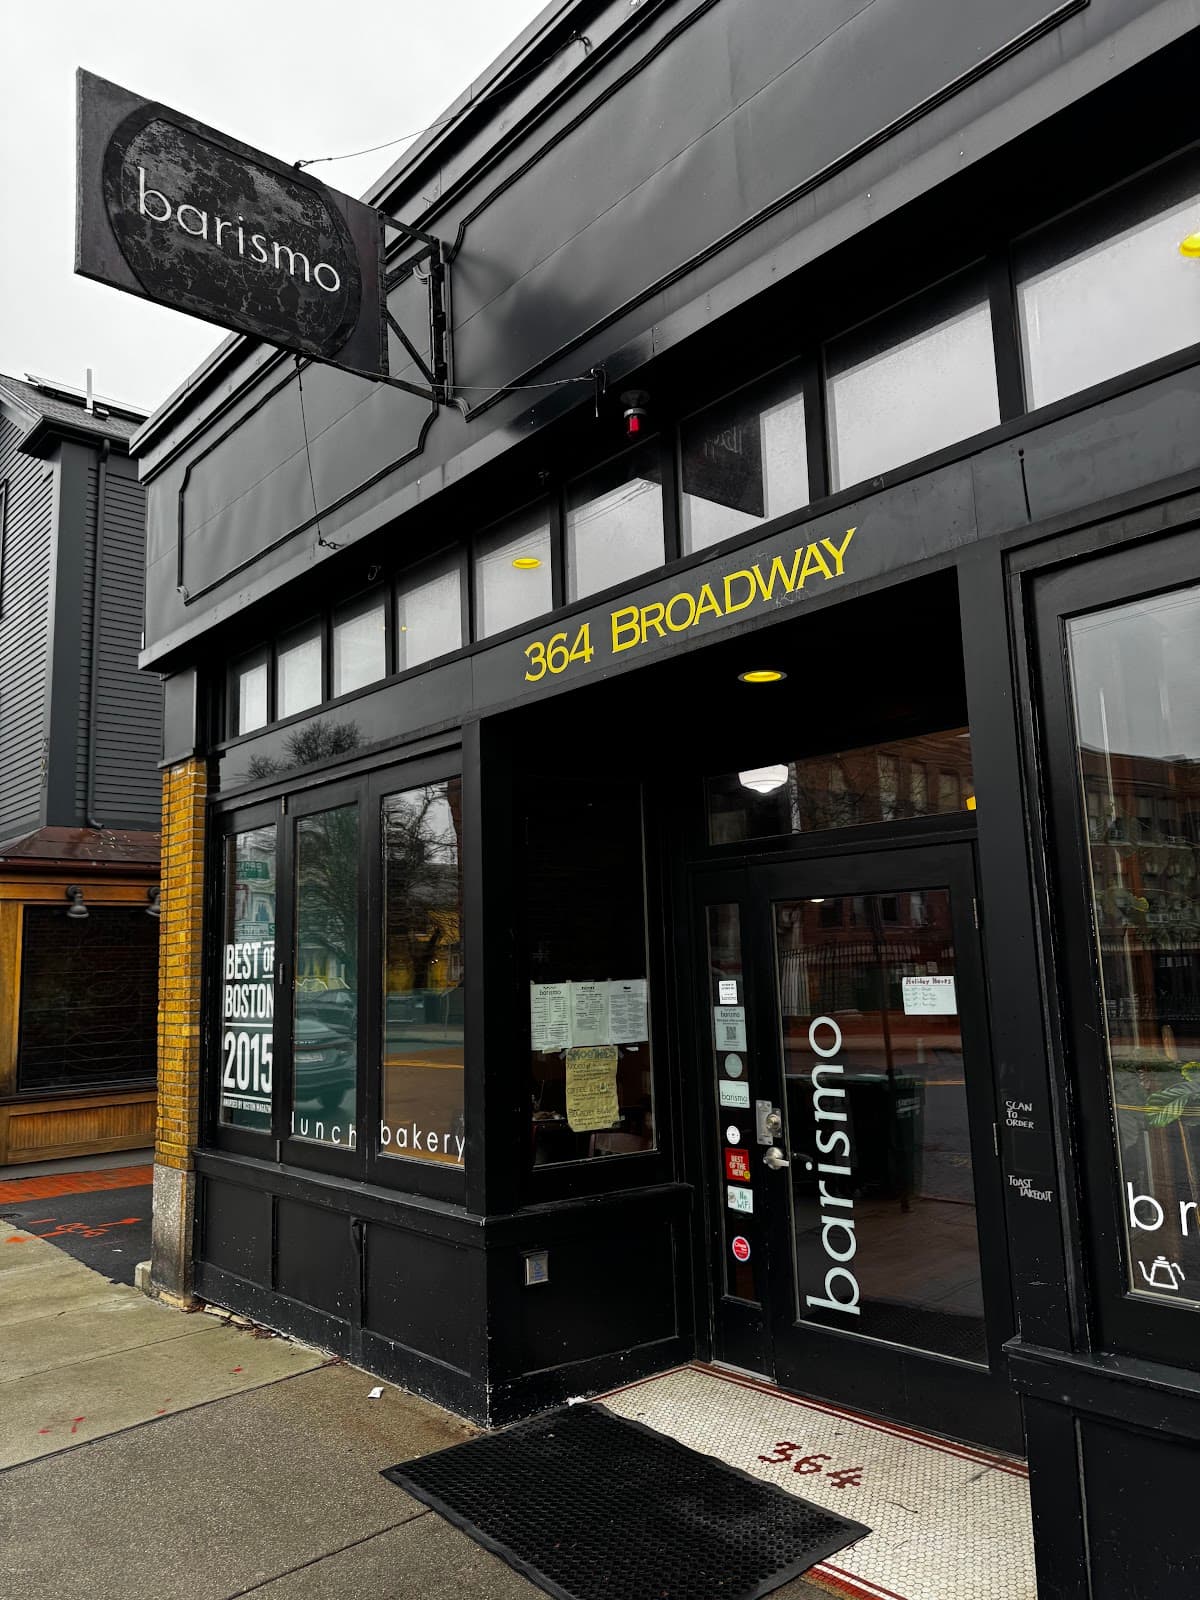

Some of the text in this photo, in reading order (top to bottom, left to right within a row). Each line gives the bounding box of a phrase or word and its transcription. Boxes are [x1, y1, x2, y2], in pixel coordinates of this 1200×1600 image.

[136, 166, 341, 293] barismo
[524, 527, 857, 682] 364 BROADWAY
[225, 941, 275, 980] BEST OF
[906, 977, 930, 986] Holiday
[224, 983, 274, 1019] BOSTON
[223, 1031, 273, 1093] 2015
[1005, 1100, 1033, 1112] SCAN
[1006, 1110, 1018, 1119] TO
[1006, 1118, 1035, 1130] ORDER
[291, 1111, 357, 1148] lunch
[380, 1120, 466, 1163] bakery
[806, 1016, 861, 1316] barismo
[1007, 1174, 1033, 1189] TOAST
[1018, 1187, 1054, 1203] TAKEOUT
[758, 1441, 864, 1489] 364
